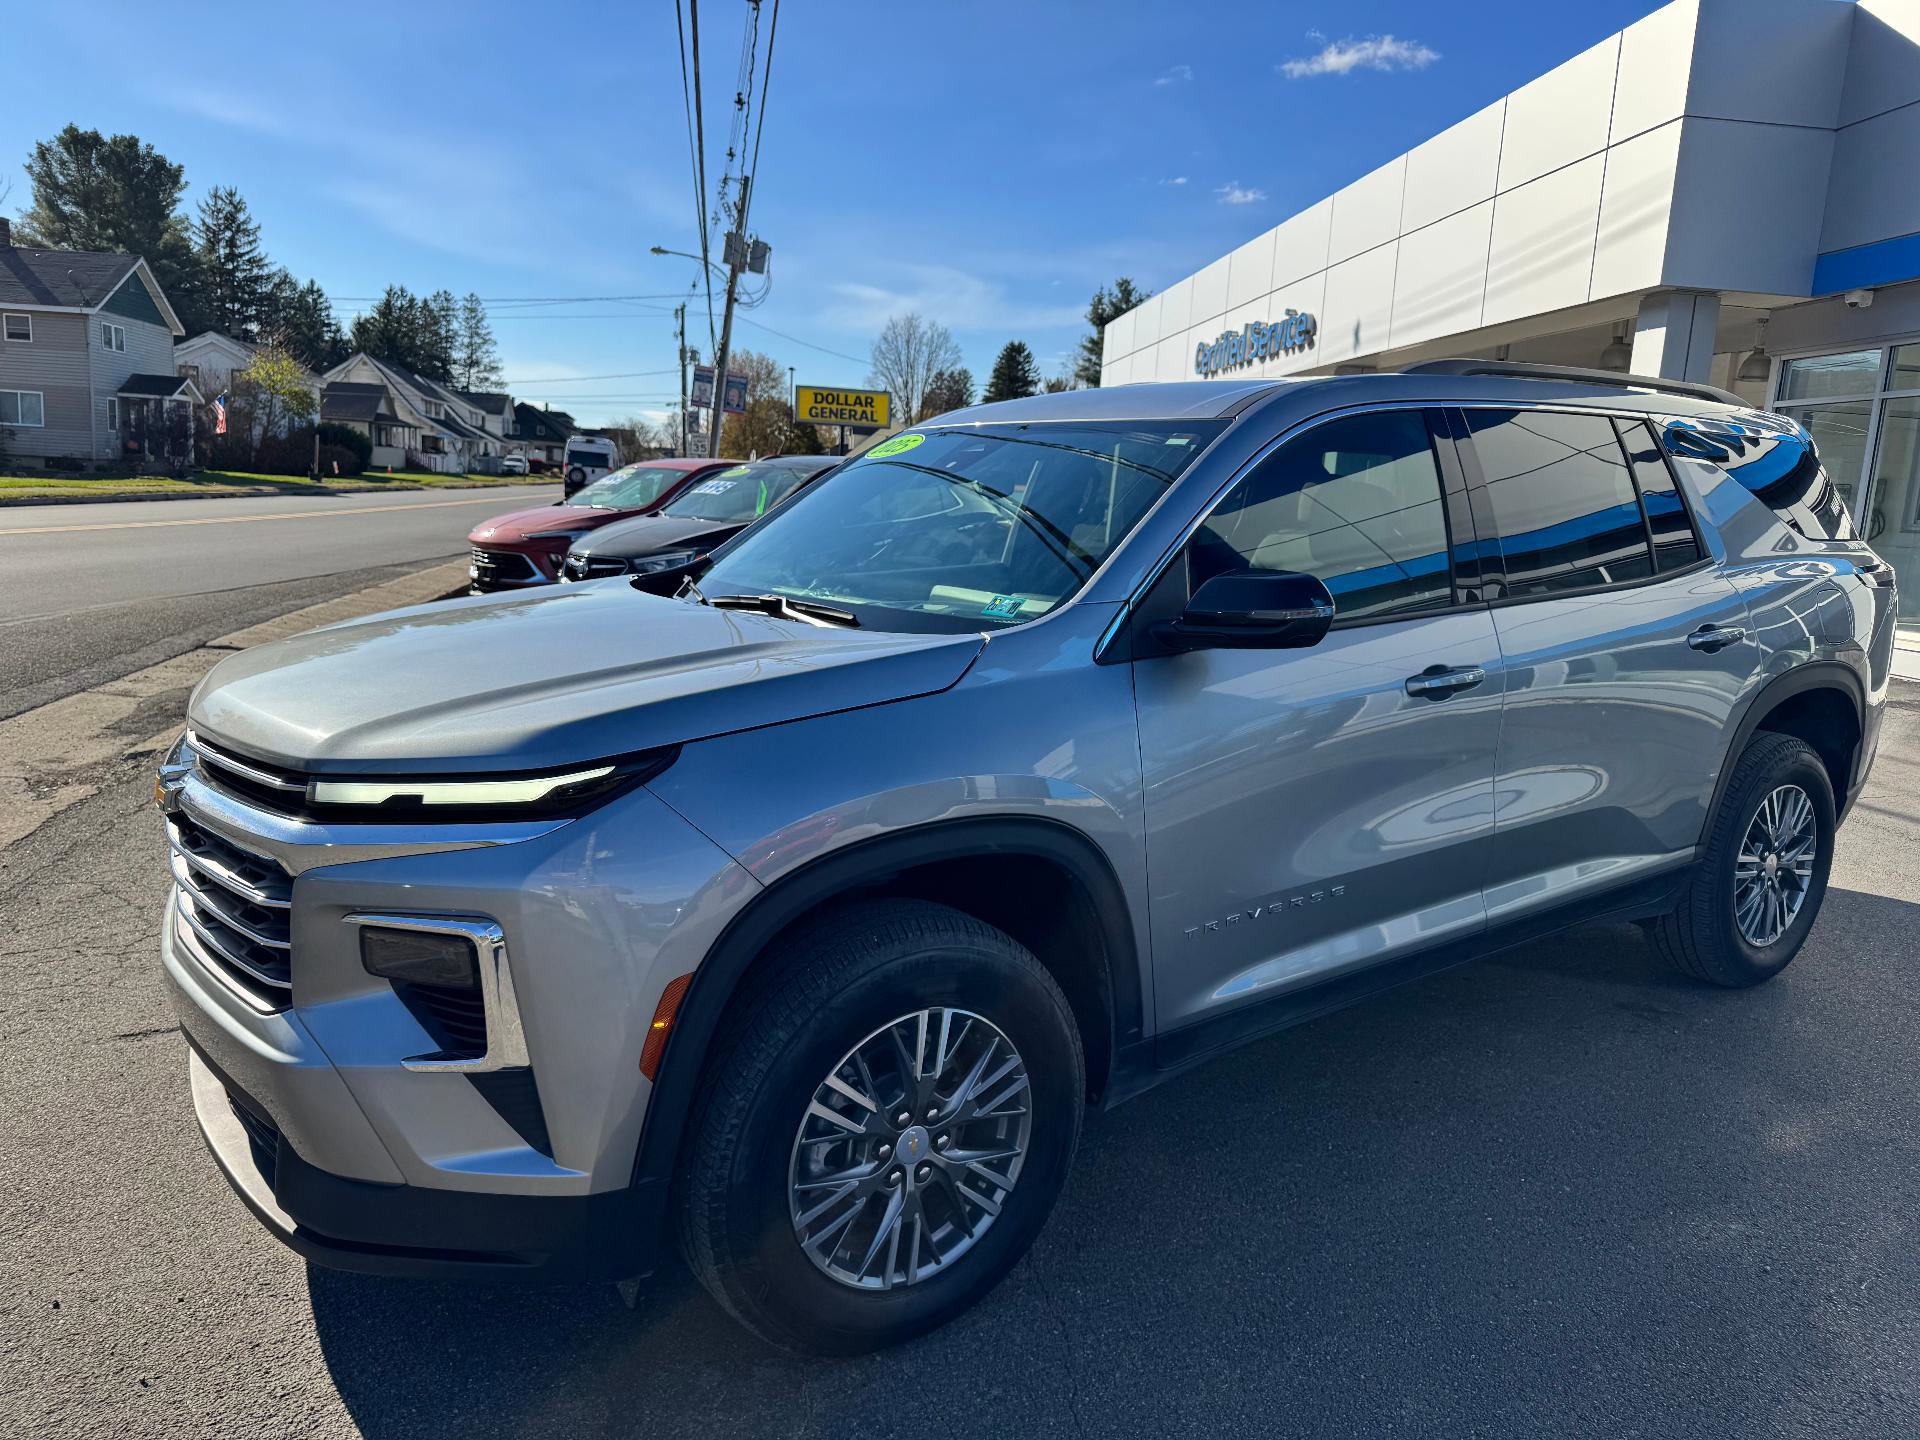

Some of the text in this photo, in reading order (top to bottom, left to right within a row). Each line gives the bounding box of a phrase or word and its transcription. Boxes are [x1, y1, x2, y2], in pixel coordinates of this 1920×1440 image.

[1194, 308, 1315, 377] Certified Service
[808, 406, 878, 422] GENERAL
[813, 392, 875, 408] DOLLAR
[1184, 886, 1345, 940] TRAVERSE
